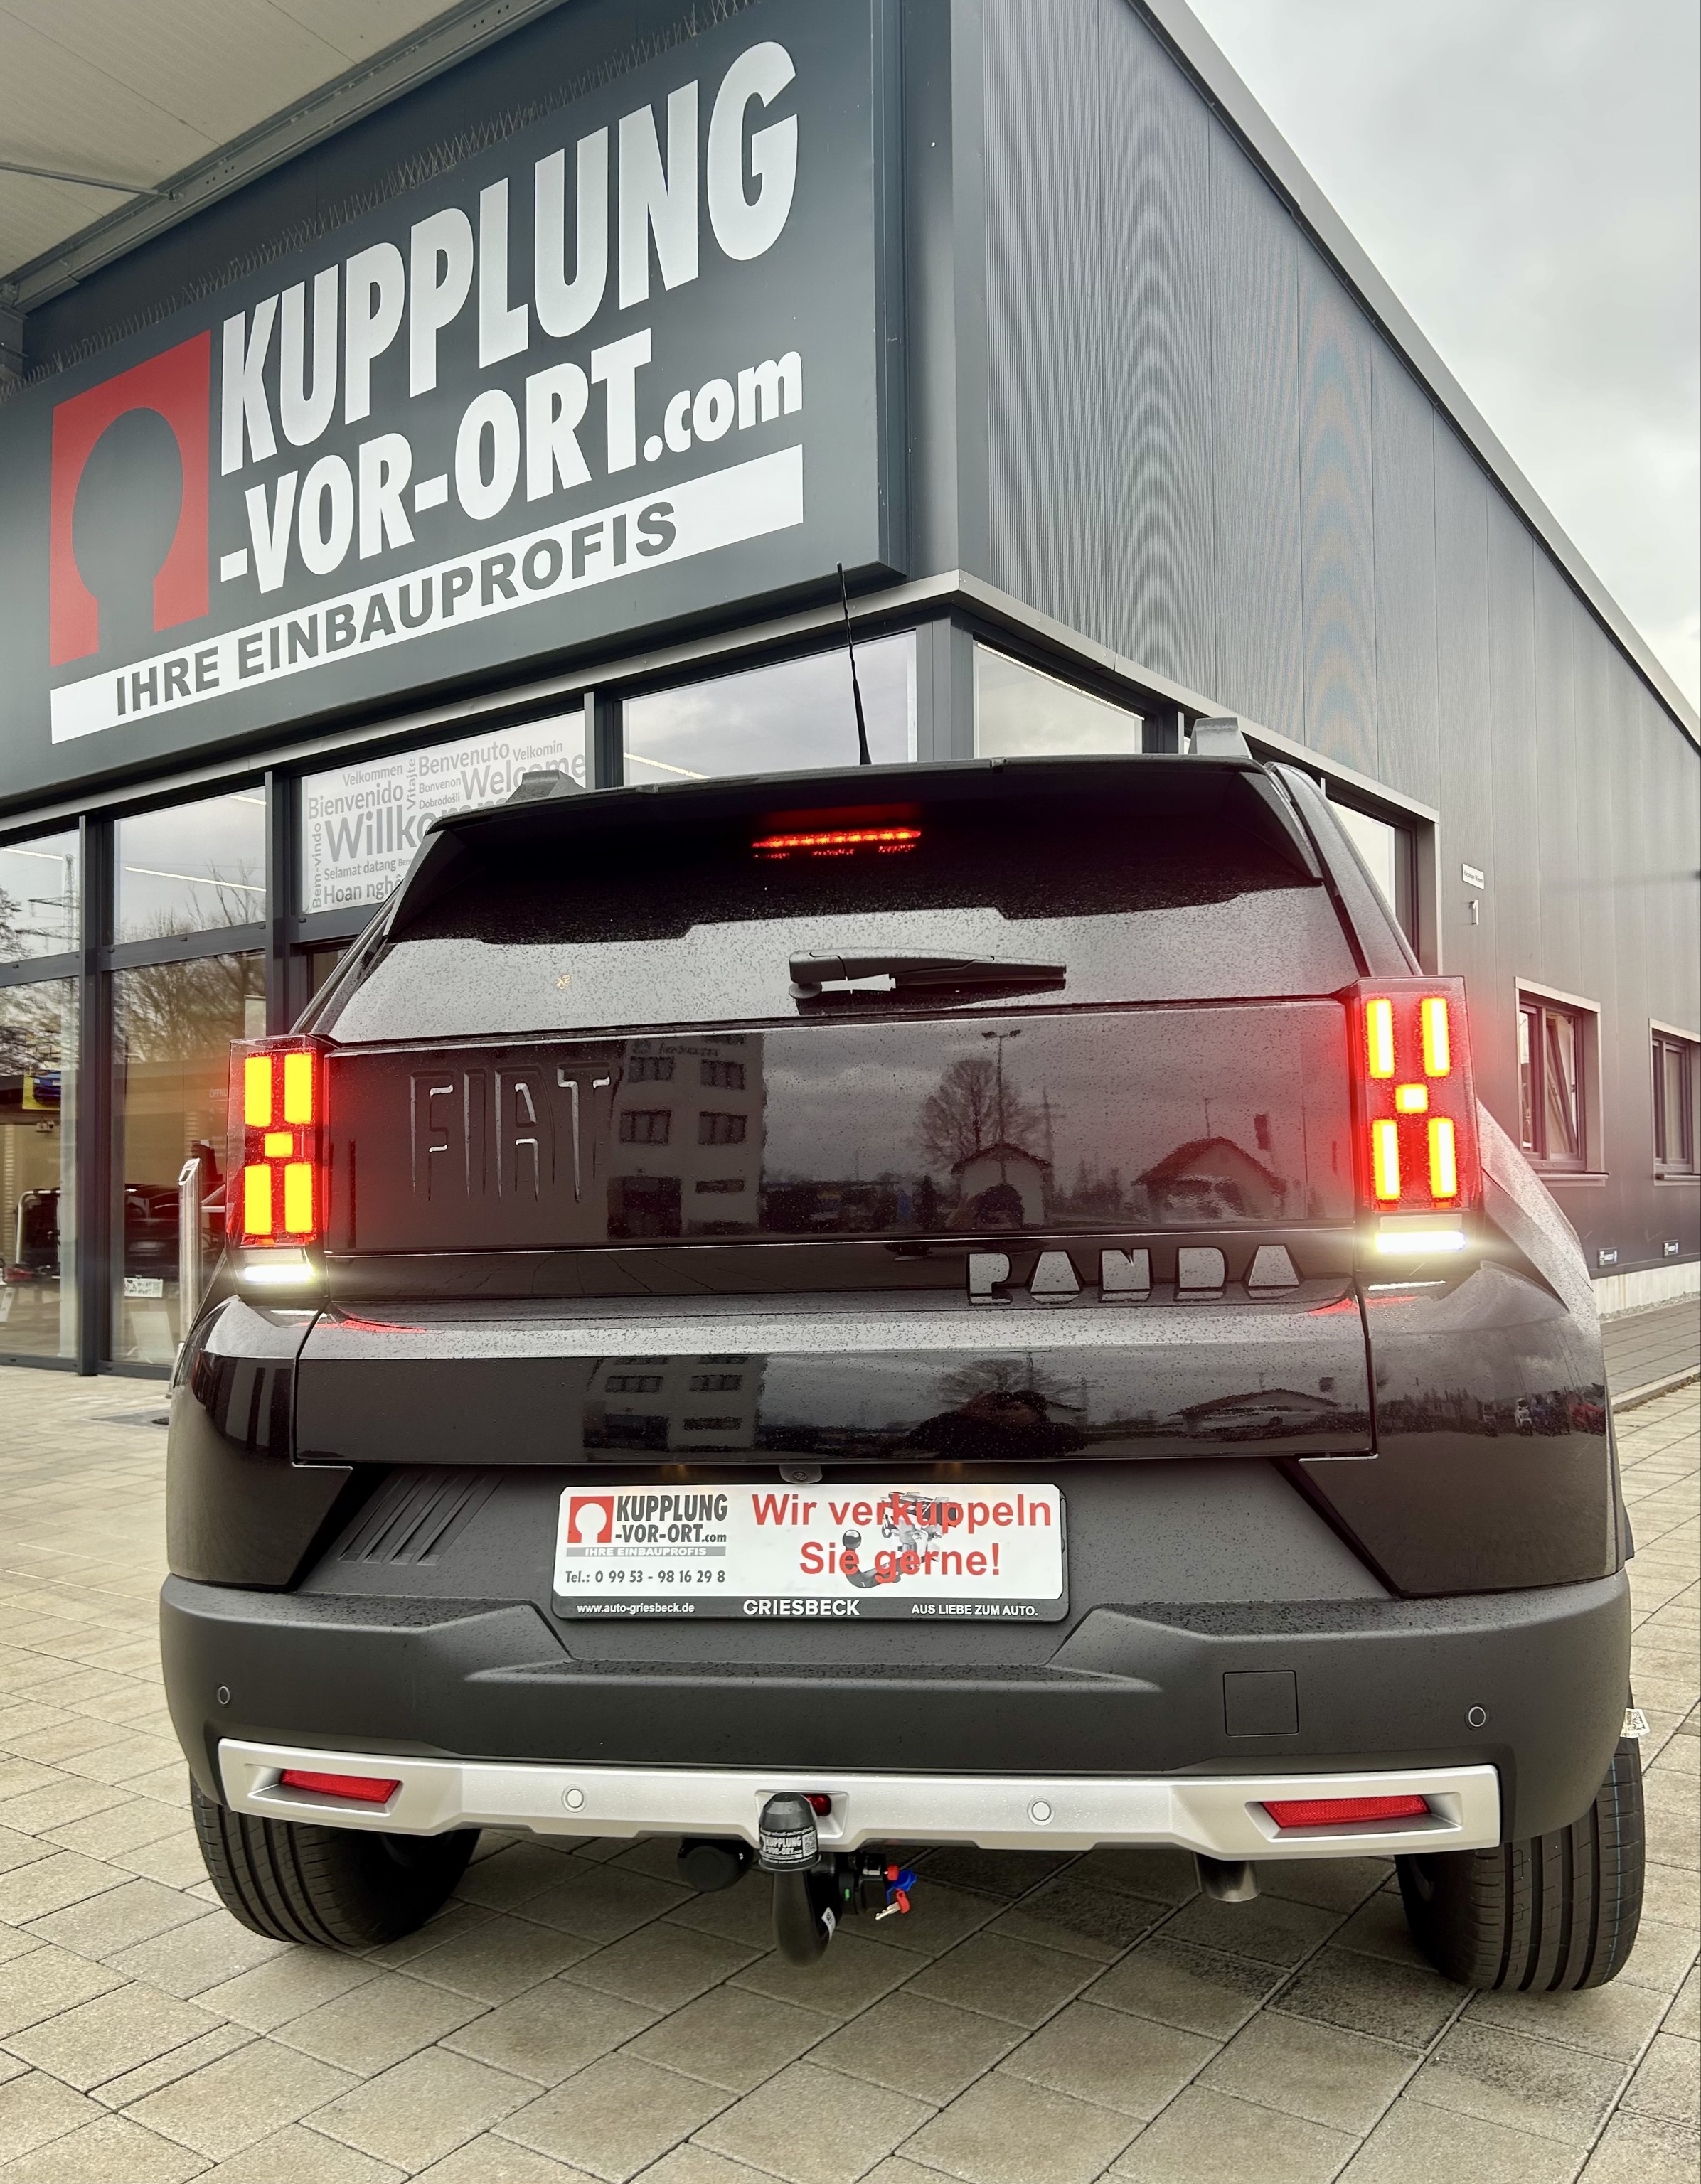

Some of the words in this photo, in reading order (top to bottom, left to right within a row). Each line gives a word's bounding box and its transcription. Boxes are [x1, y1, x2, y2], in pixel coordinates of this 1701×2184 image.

[220, 41, 798, 476] KUPPLUNG
[220, 327, 803, 593] -VOR-ORT.com
[117, 644, 219, 717] IHRE
[238, 500, 676, 678] EINBAUPROFIS
[419, 742, 509, 777] Benvenuto
[513, 740, 562, 761] Velkomin
[343, 765, 403, 786] Velkommen
[407, 759, 417, 810] Vitajte
[419, 777, 461, 794] Bonvenon
[308, 781, 403, 819] Bienvenido
[419, 793, 460, 810] Dobrodošli
[311, 823, 321, 909] Bem-vindo
[324, 864, 361, 880] Selamat
[363, 860, 396, 874] datang
[324, 885, 362, 904] Hoan
[410, 1062, 610, 1202] FIAT
[966, 1243, 1303, 1296] PANDA
[616, 1494, 728, 1522] KUPPLUNG
[752, 1494, 816, 1526] Wir
[828, 1493, 1052, 1534] verkuppeln
[615, 1524, 727, 1543] -VOR-ORT.com
[585, 1548, 614, 1556] IHRE
[617, 1547, 707, 1556] EINBAUPROFIS
[800, 1541, 859, 1575] Sie
[875, 1543, 1000, 1584] gerne!
[565, 1570, 590, 1583] Tel.:
[595, 1570, 603, 1583] 0
[609, 1570, 625, 1583] 99
[629, 1570, 643, 1583] 53
[658, 1570, 675, 1583] 98
[679, 1570, 691, 1583] 16
[697, 1570, 712, 1583] 29
[717, 1570, 725, 1583] 8
[577, 1603, 695, 1615] www.auto-griesbeck.de
[742, 1599, 860, 1616] GRIESBECK
[911, 1604, 936, 1615] AUS
[939, 1605, 972, 1615] LIEBE
[974, 1605, 1000, 1615] ZUM
[1002, 1605, 1038, 1616] AUTO.
